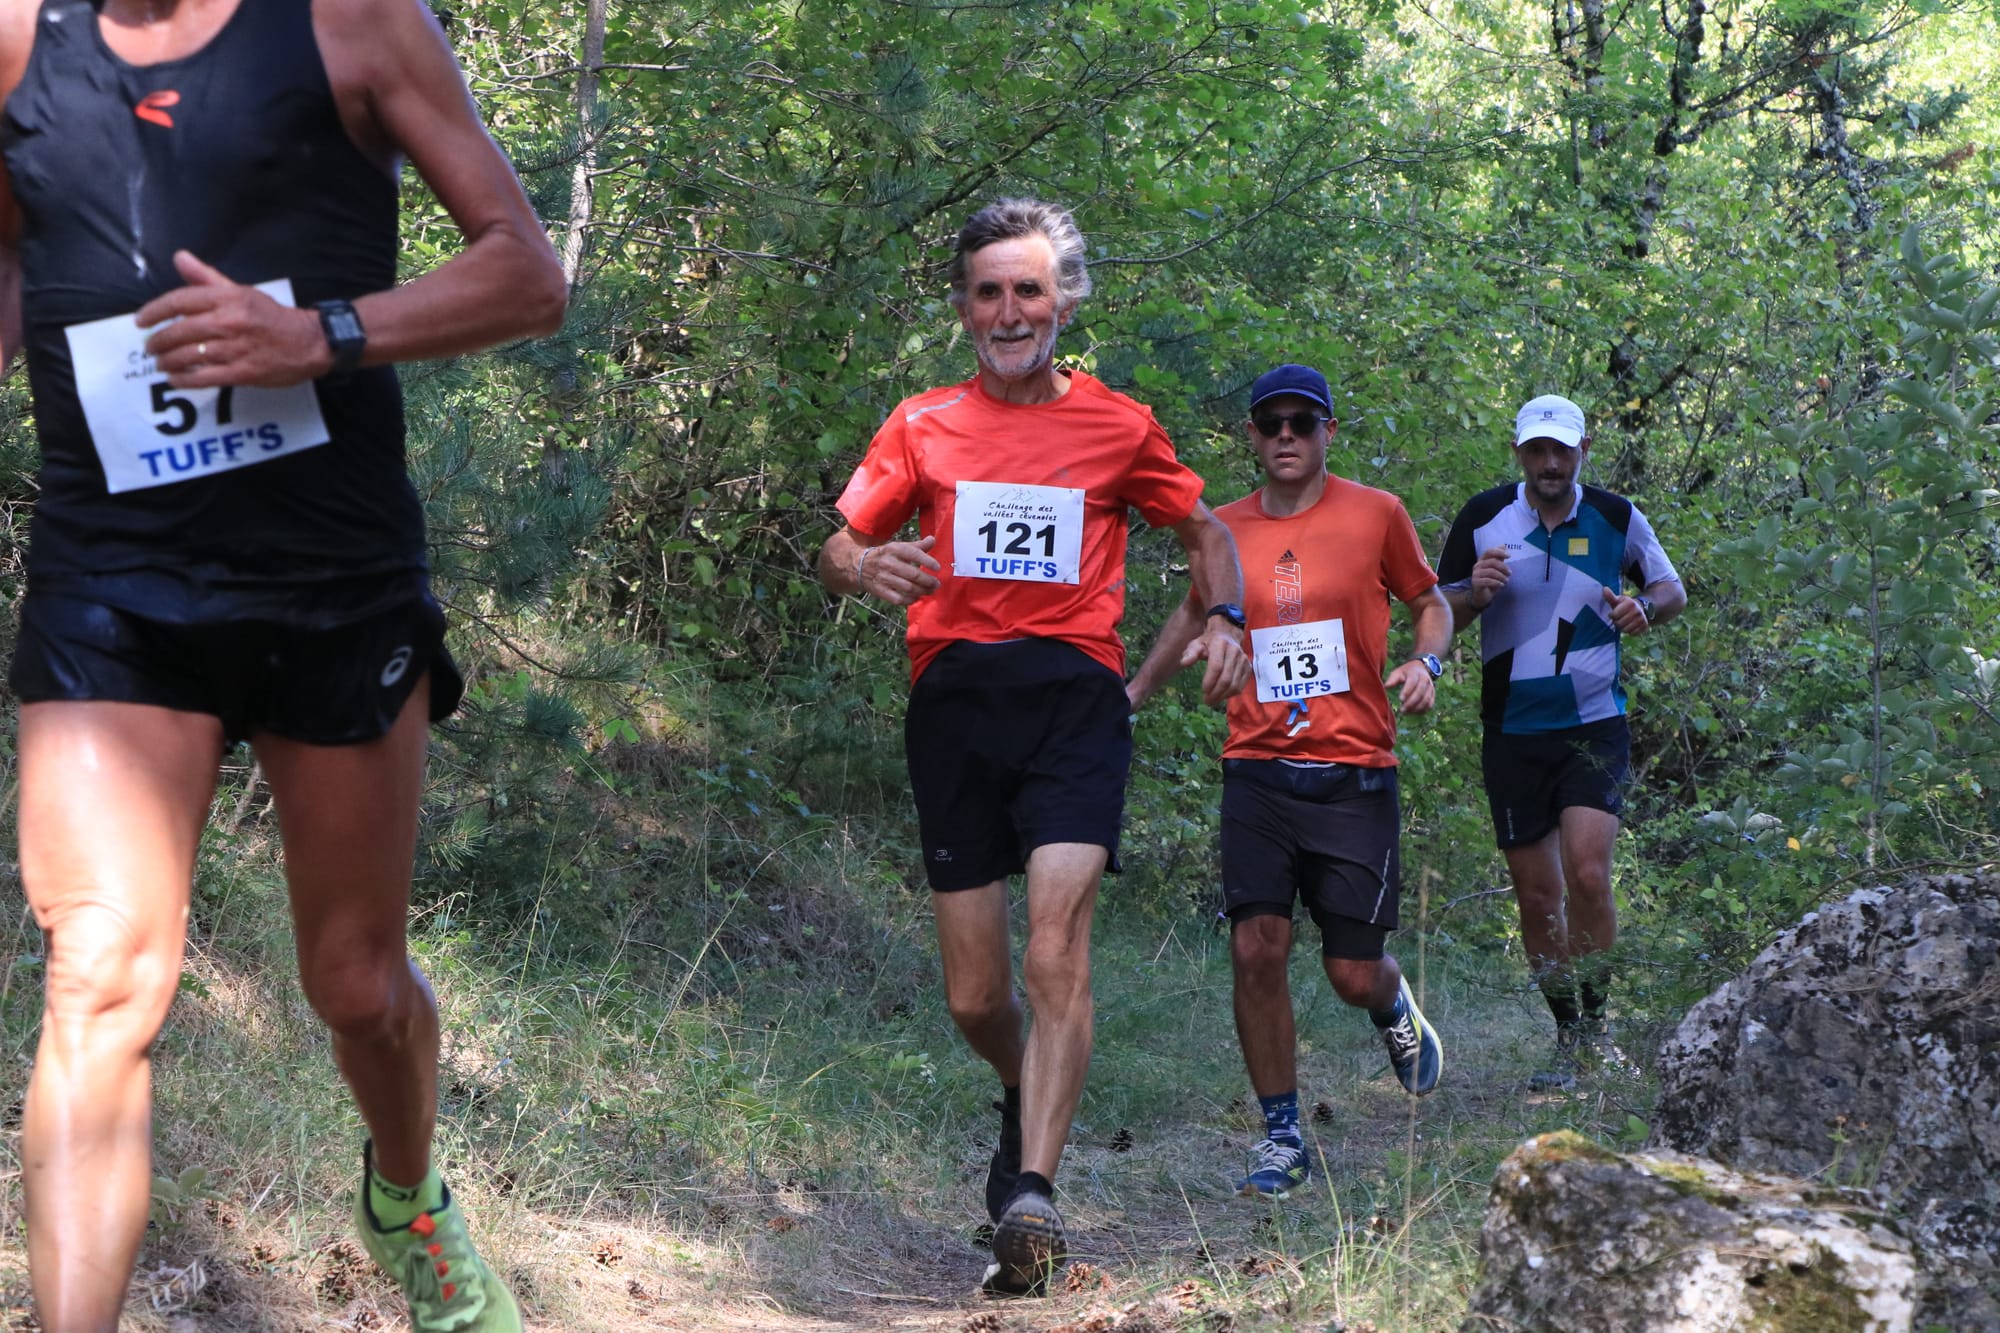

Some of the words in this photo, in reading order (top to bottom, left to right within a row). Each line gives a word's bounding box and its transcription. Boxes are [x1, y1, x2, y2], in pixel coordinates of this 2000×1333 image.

[139, 423, 284, 477] TUFF'S
[988, 501, 1033, 513] Challenge
[978, 520, 1056, 558] 121
[975, 557, 1058, 578] TUFF'S
[1277, 652, 1319, 681] 13
[1270, 679, 1332, 699] TUFF'S
